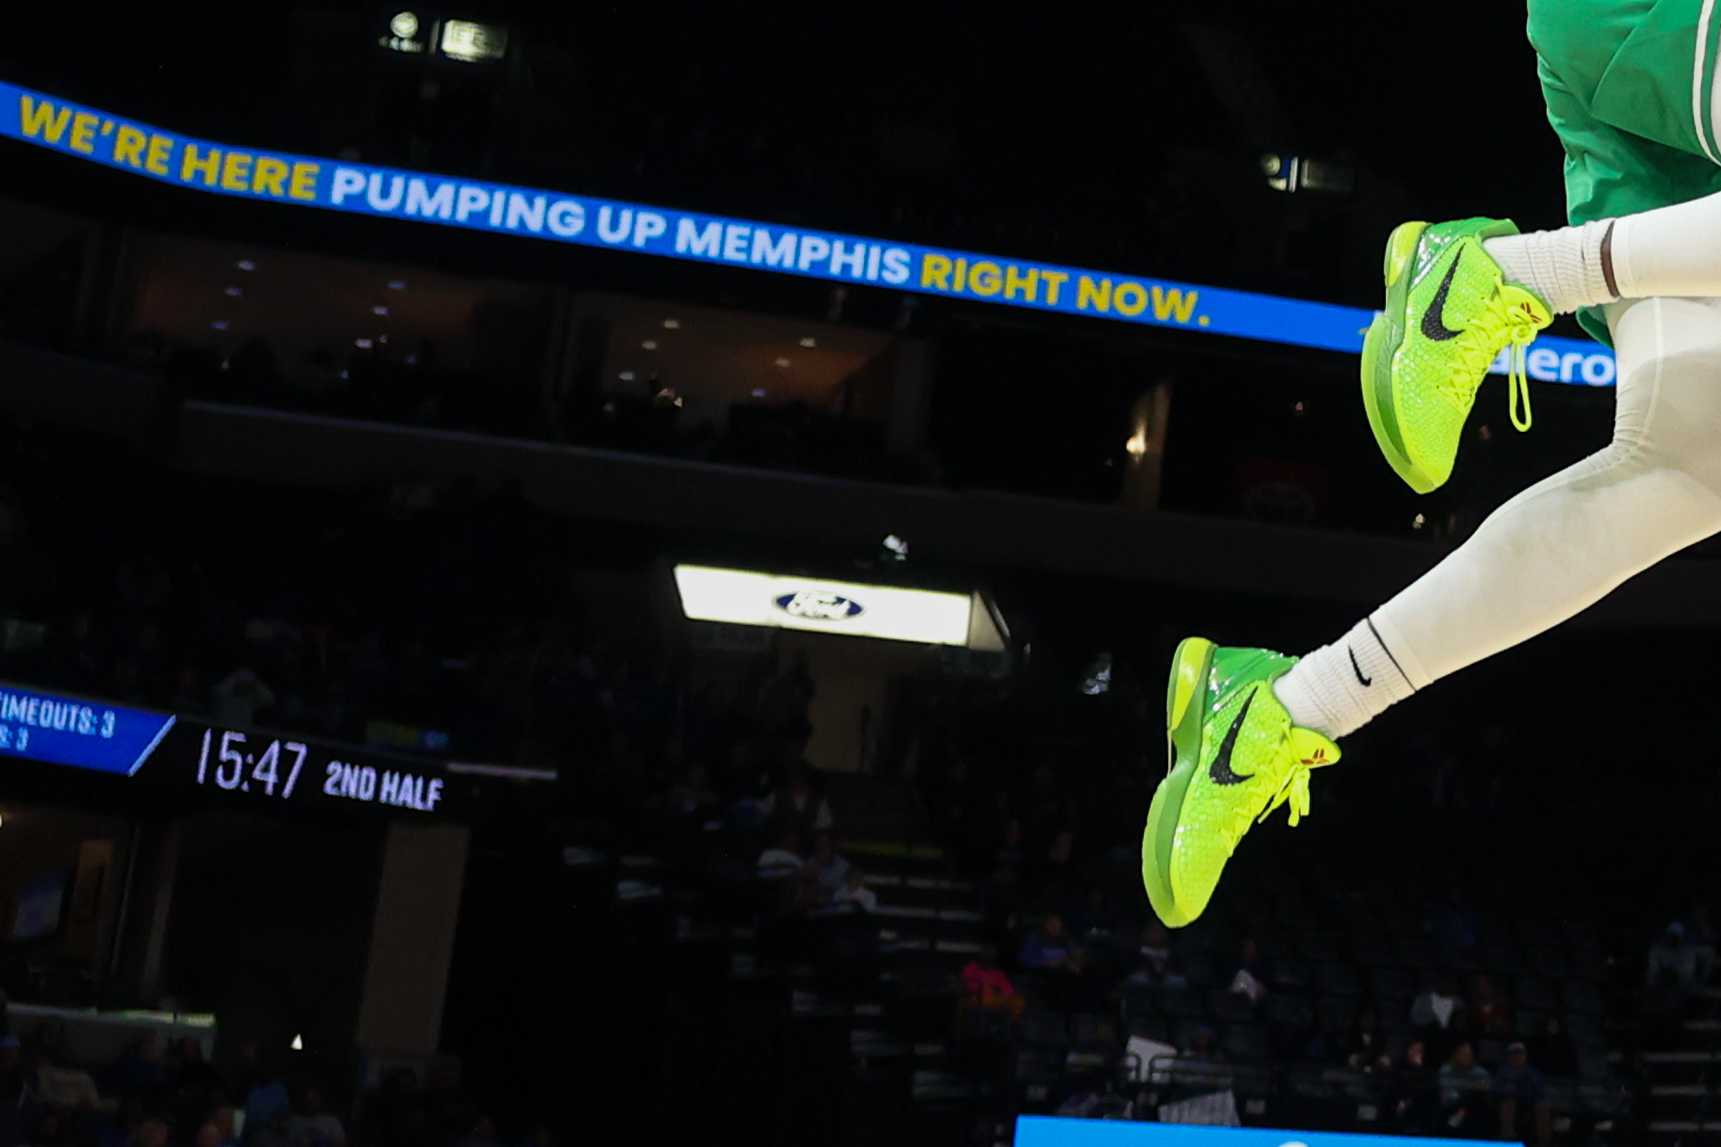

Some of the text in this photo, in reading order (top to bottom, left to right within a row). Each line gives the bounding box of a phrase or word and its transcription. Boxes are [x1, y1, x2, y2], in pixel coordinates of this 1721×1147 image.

[19, 95, 1211, 327] WE'RE HERE PUMPING UP MEMPHIS RIGHT NOW.
[0, 692, 115, 738] IMEOUTS: 3
[16, 726, 28, 751] 3
[197, 728, 444, 812] 15:47 2ND HALF
